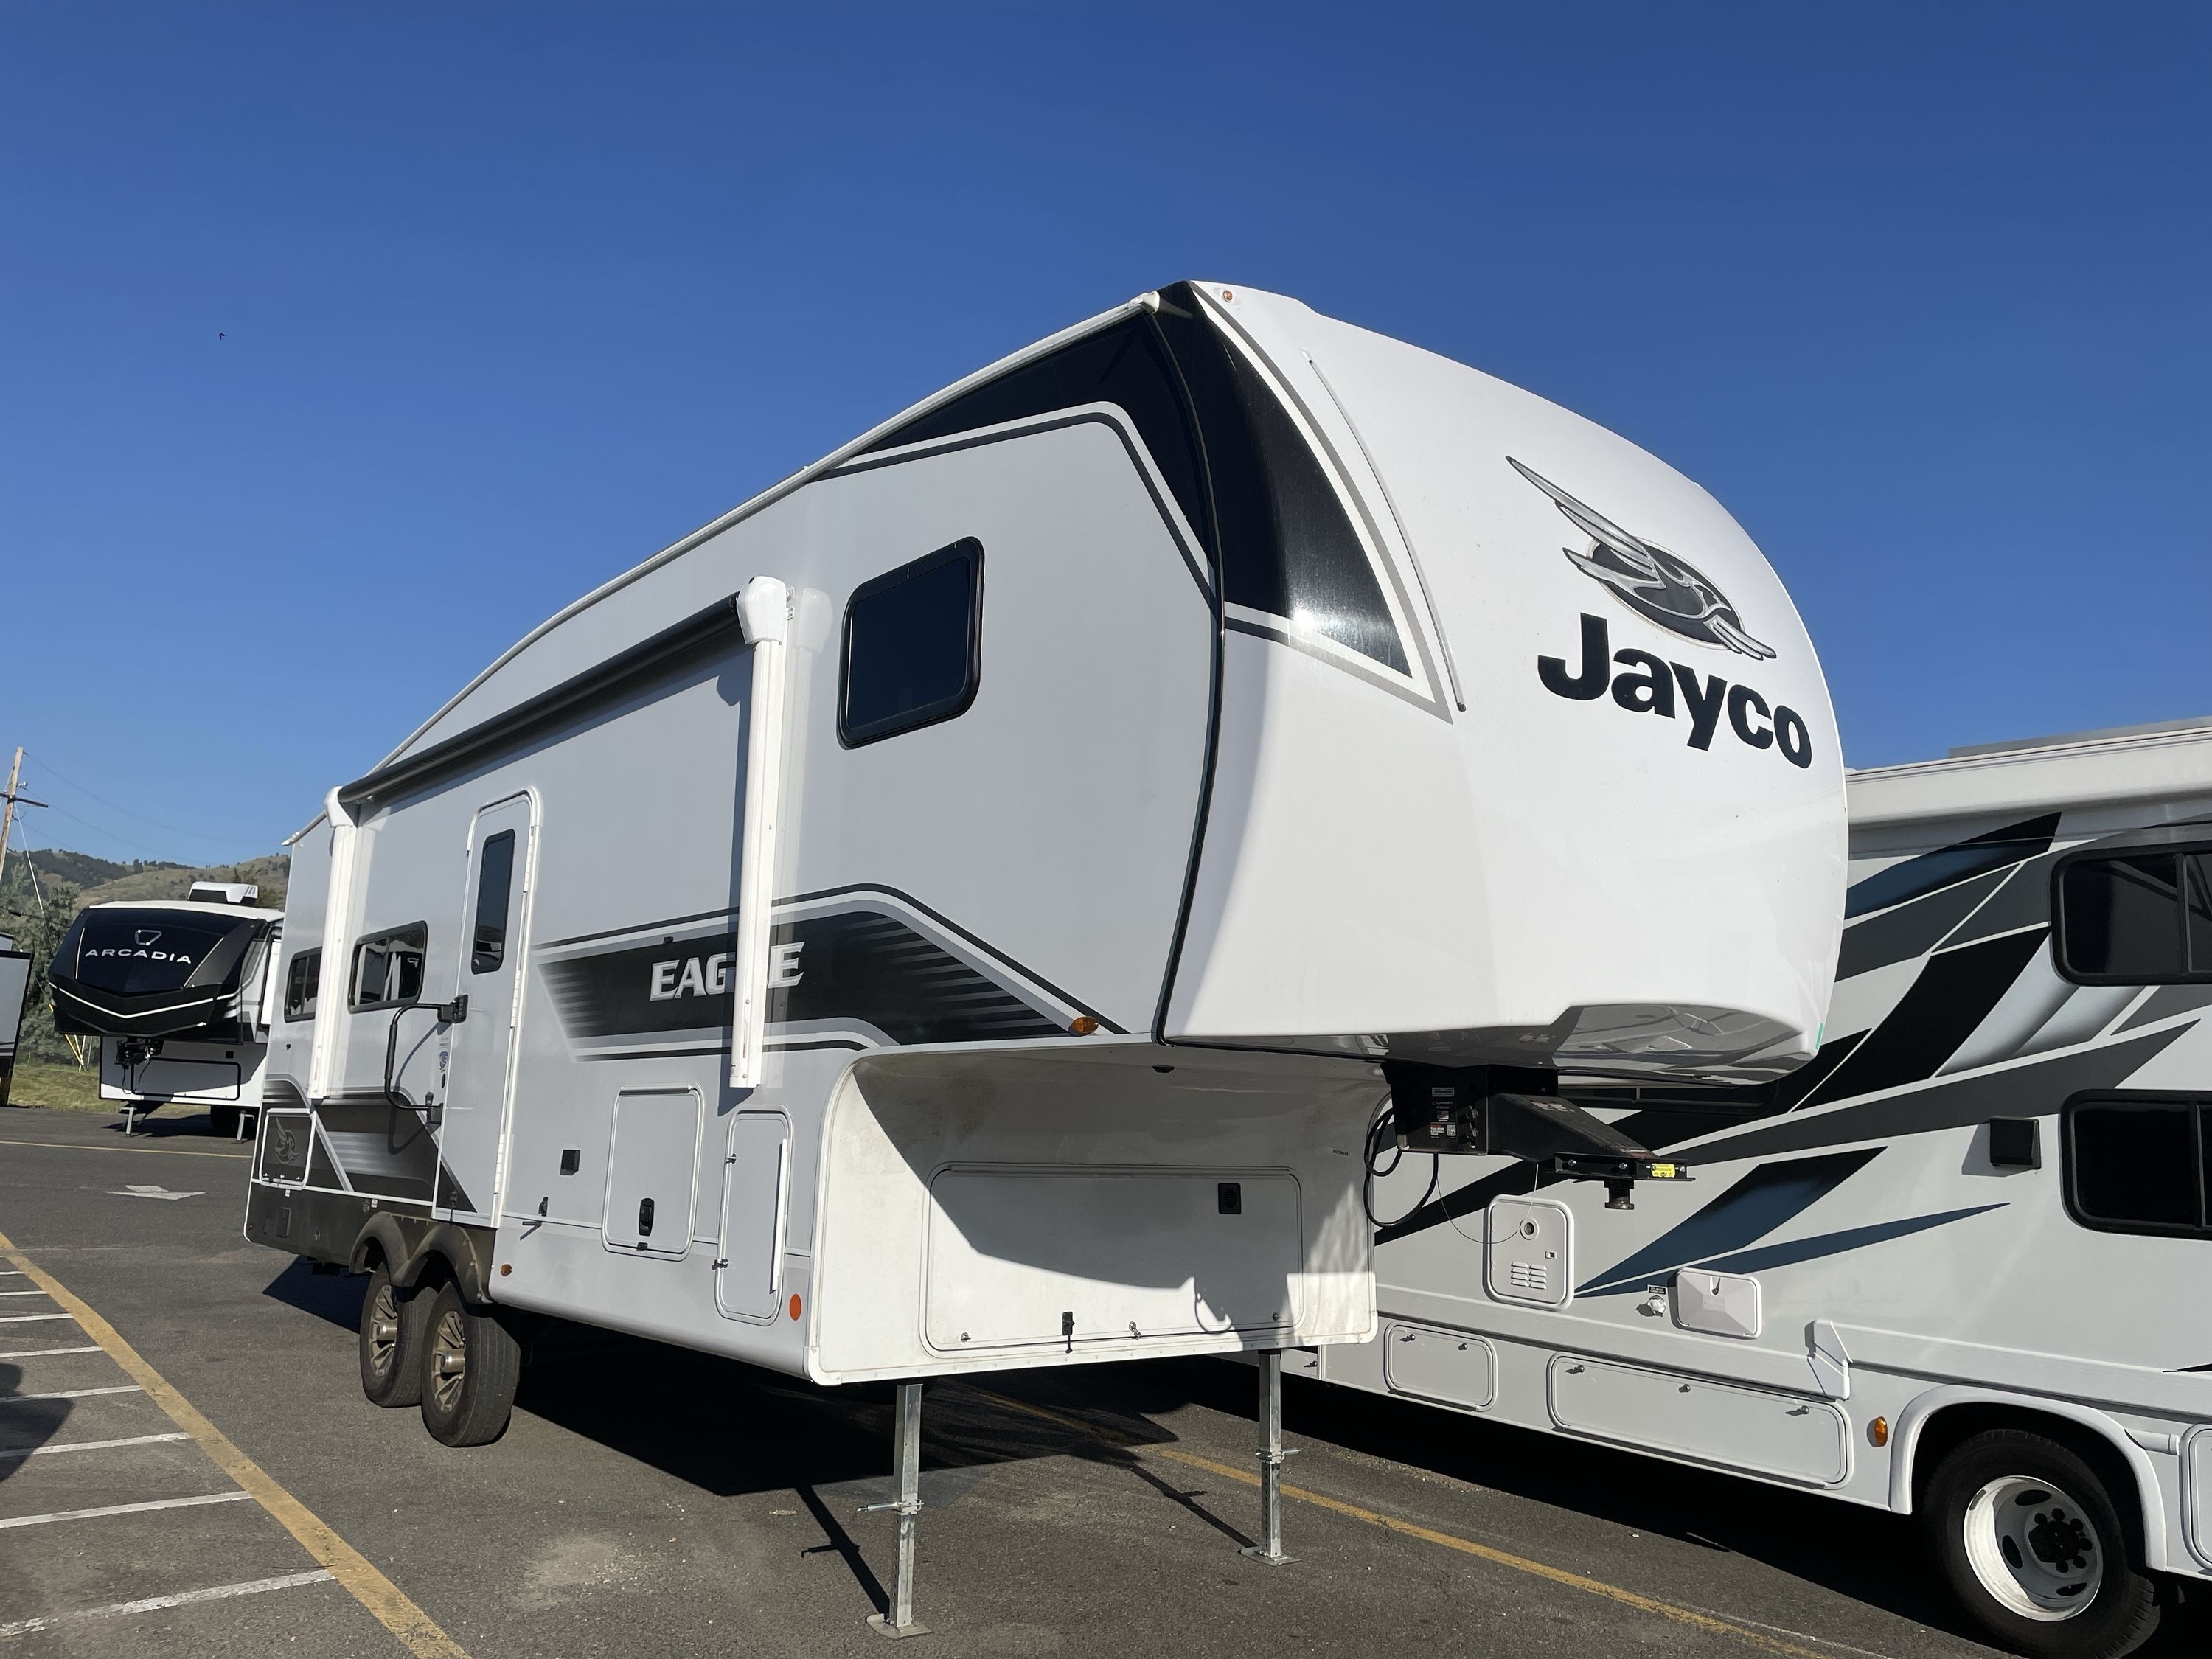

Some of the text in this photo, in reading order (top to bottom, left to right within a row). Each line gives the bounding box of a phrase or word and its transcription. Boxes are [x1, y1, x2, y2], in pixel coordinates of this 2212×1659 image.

[1537, 612, 1812, 769] Jayco
[85, 948, 192, 964] ARCADIA
[649, 941, 805, 1001] EAGE
